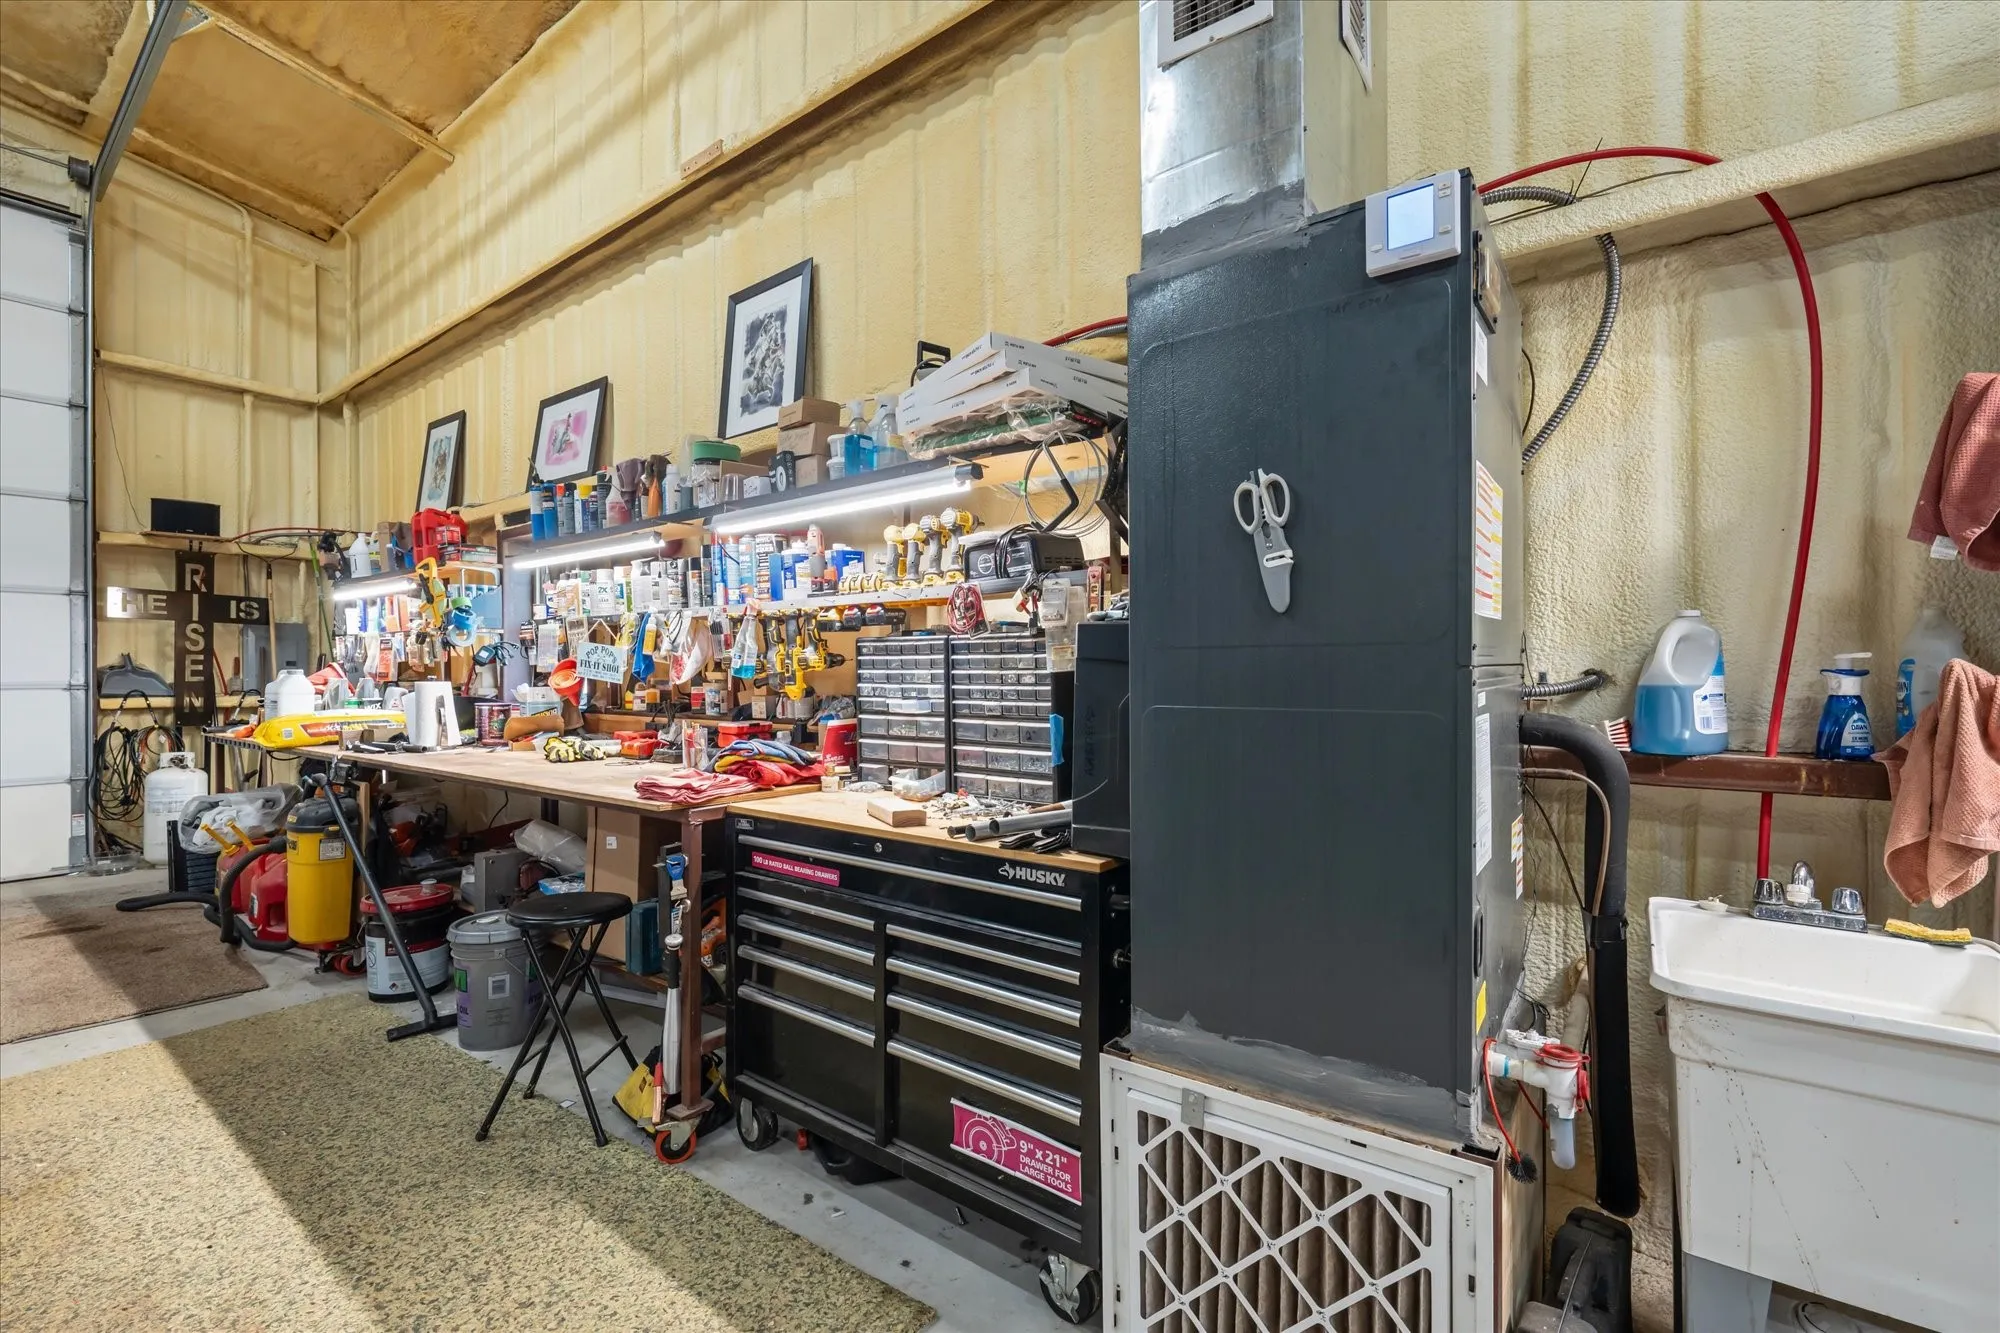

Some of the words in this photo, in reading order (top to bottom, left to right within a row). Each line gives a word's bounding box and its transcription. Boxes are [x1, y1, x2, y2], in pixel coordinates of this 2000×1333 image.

[122, 592, 168, 614] HE
[229, 600, 260, 620] IS
[184, 563, 207, 713] RISEN
[580, 659, 601, 670] FIX-IT
[586, 646, 599, 659] POP
[753, 856, 762, 864] 100
[769, 860, 782, 869] RATED
[783, 863, 793, 871] BALL
[794, 866, 814, 876] BEARING
[815, 870, 838, 881] DRAWERS
[1015, 866, 1065, 887] HUSKY
[460, 1006, 469, 1015] OIL
[1020, 1141, 1034, 1153] 9"
[1045, 1150, 1067, 1168] 21"
[1020, 1155, 1054, 1175] DRAWER
[1055, 1169, 1071, 1182] FOR
[1020, 1164, 1045, 1181] LARGE
[1047, 1176, 1073, 1192] TOOLS
